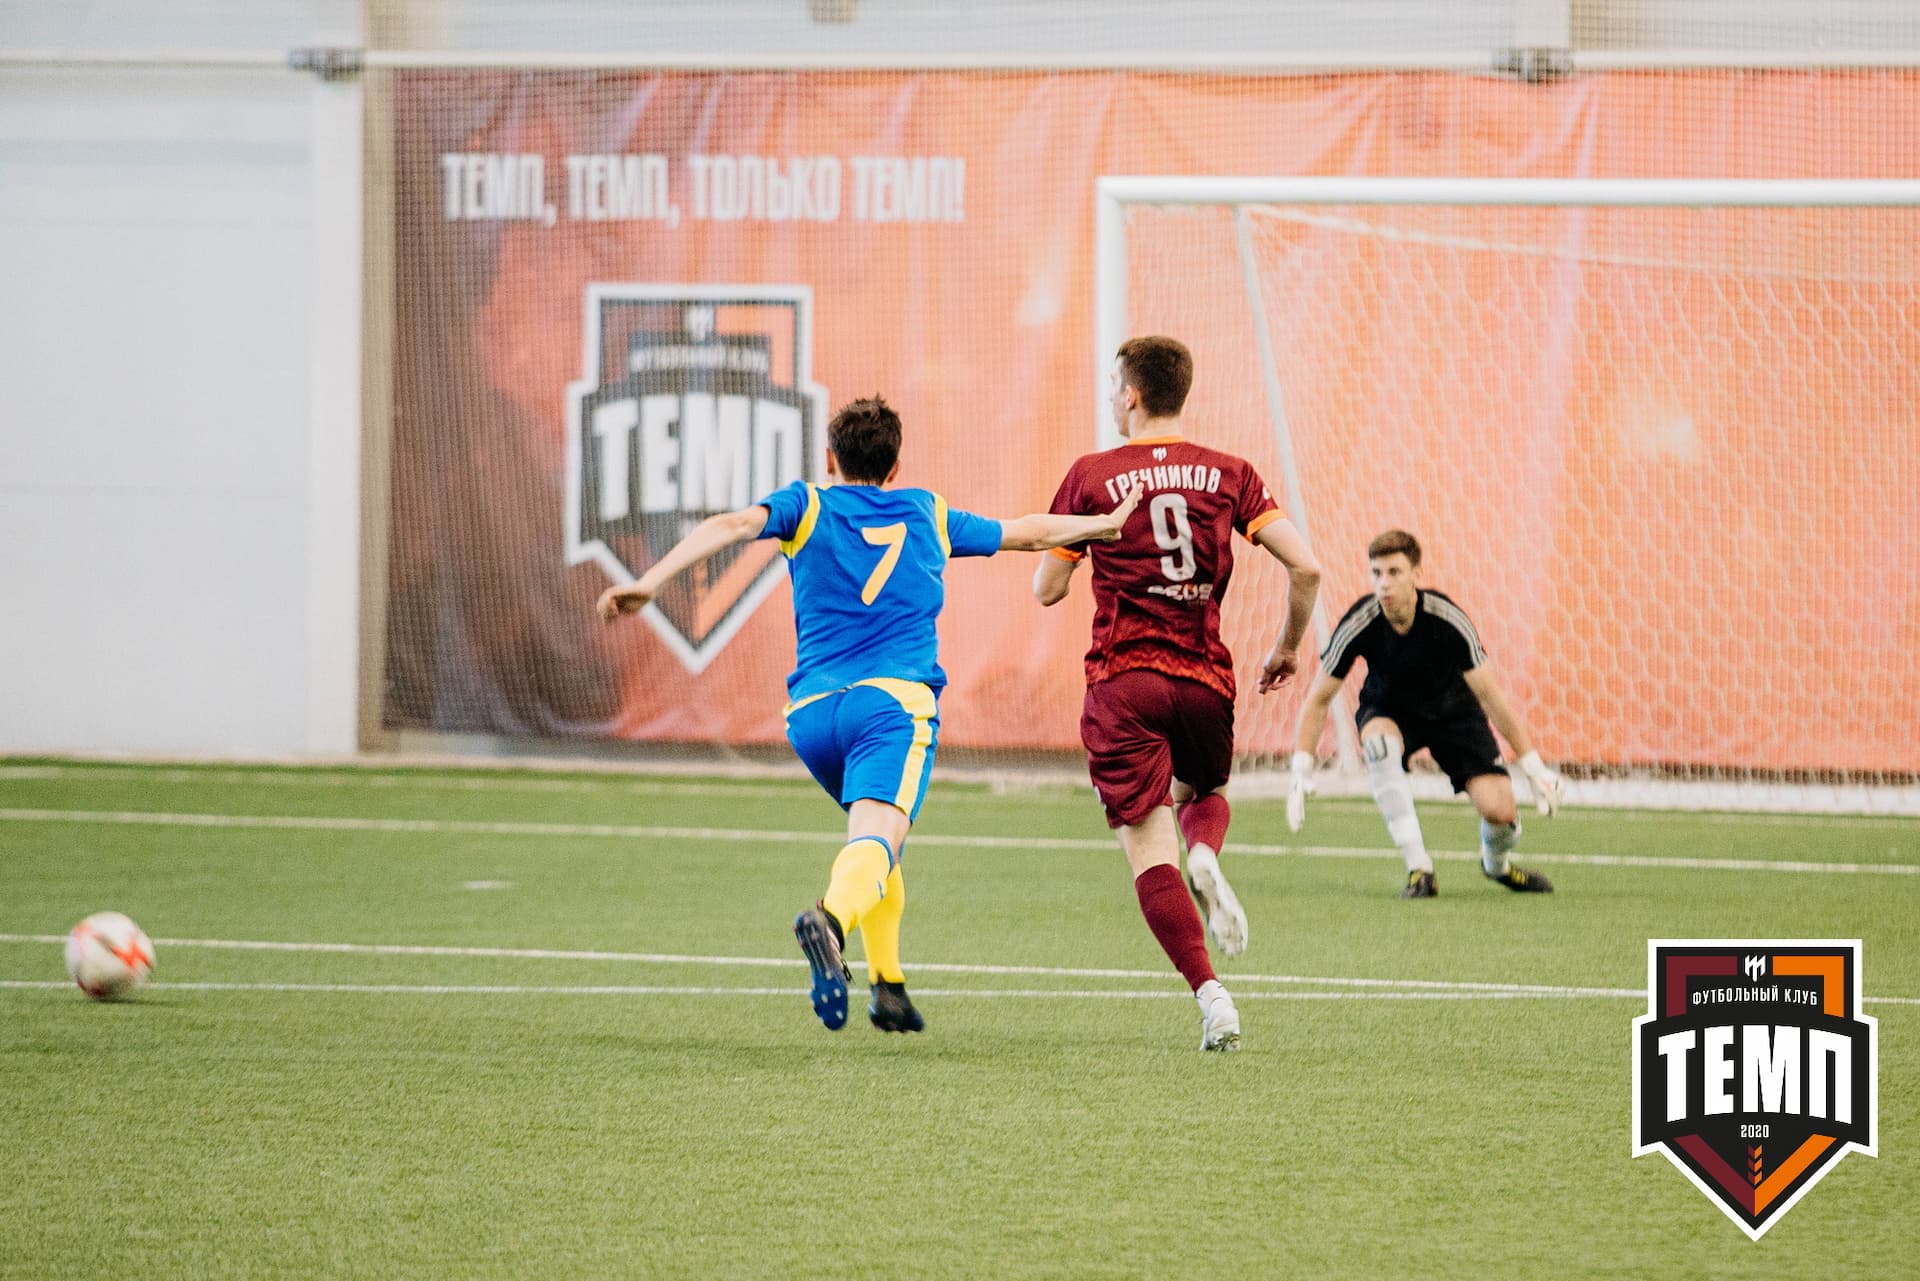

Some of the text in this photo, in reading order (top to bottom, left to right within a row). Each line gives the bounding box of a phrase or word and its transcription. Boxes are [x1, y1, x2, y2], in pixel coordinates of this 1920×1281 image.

[443, 154, 965, 229] ТЕМП, ТЕМП, ТОЛЬКО ТЕМП!
[592, 391, 803, 522] ТЕМП
[1104, 464, 1222, 504] ГРЕЧНИКОВ
[861, 522, 908, 607] 7
[1150, 493, 1198, 582] 9
